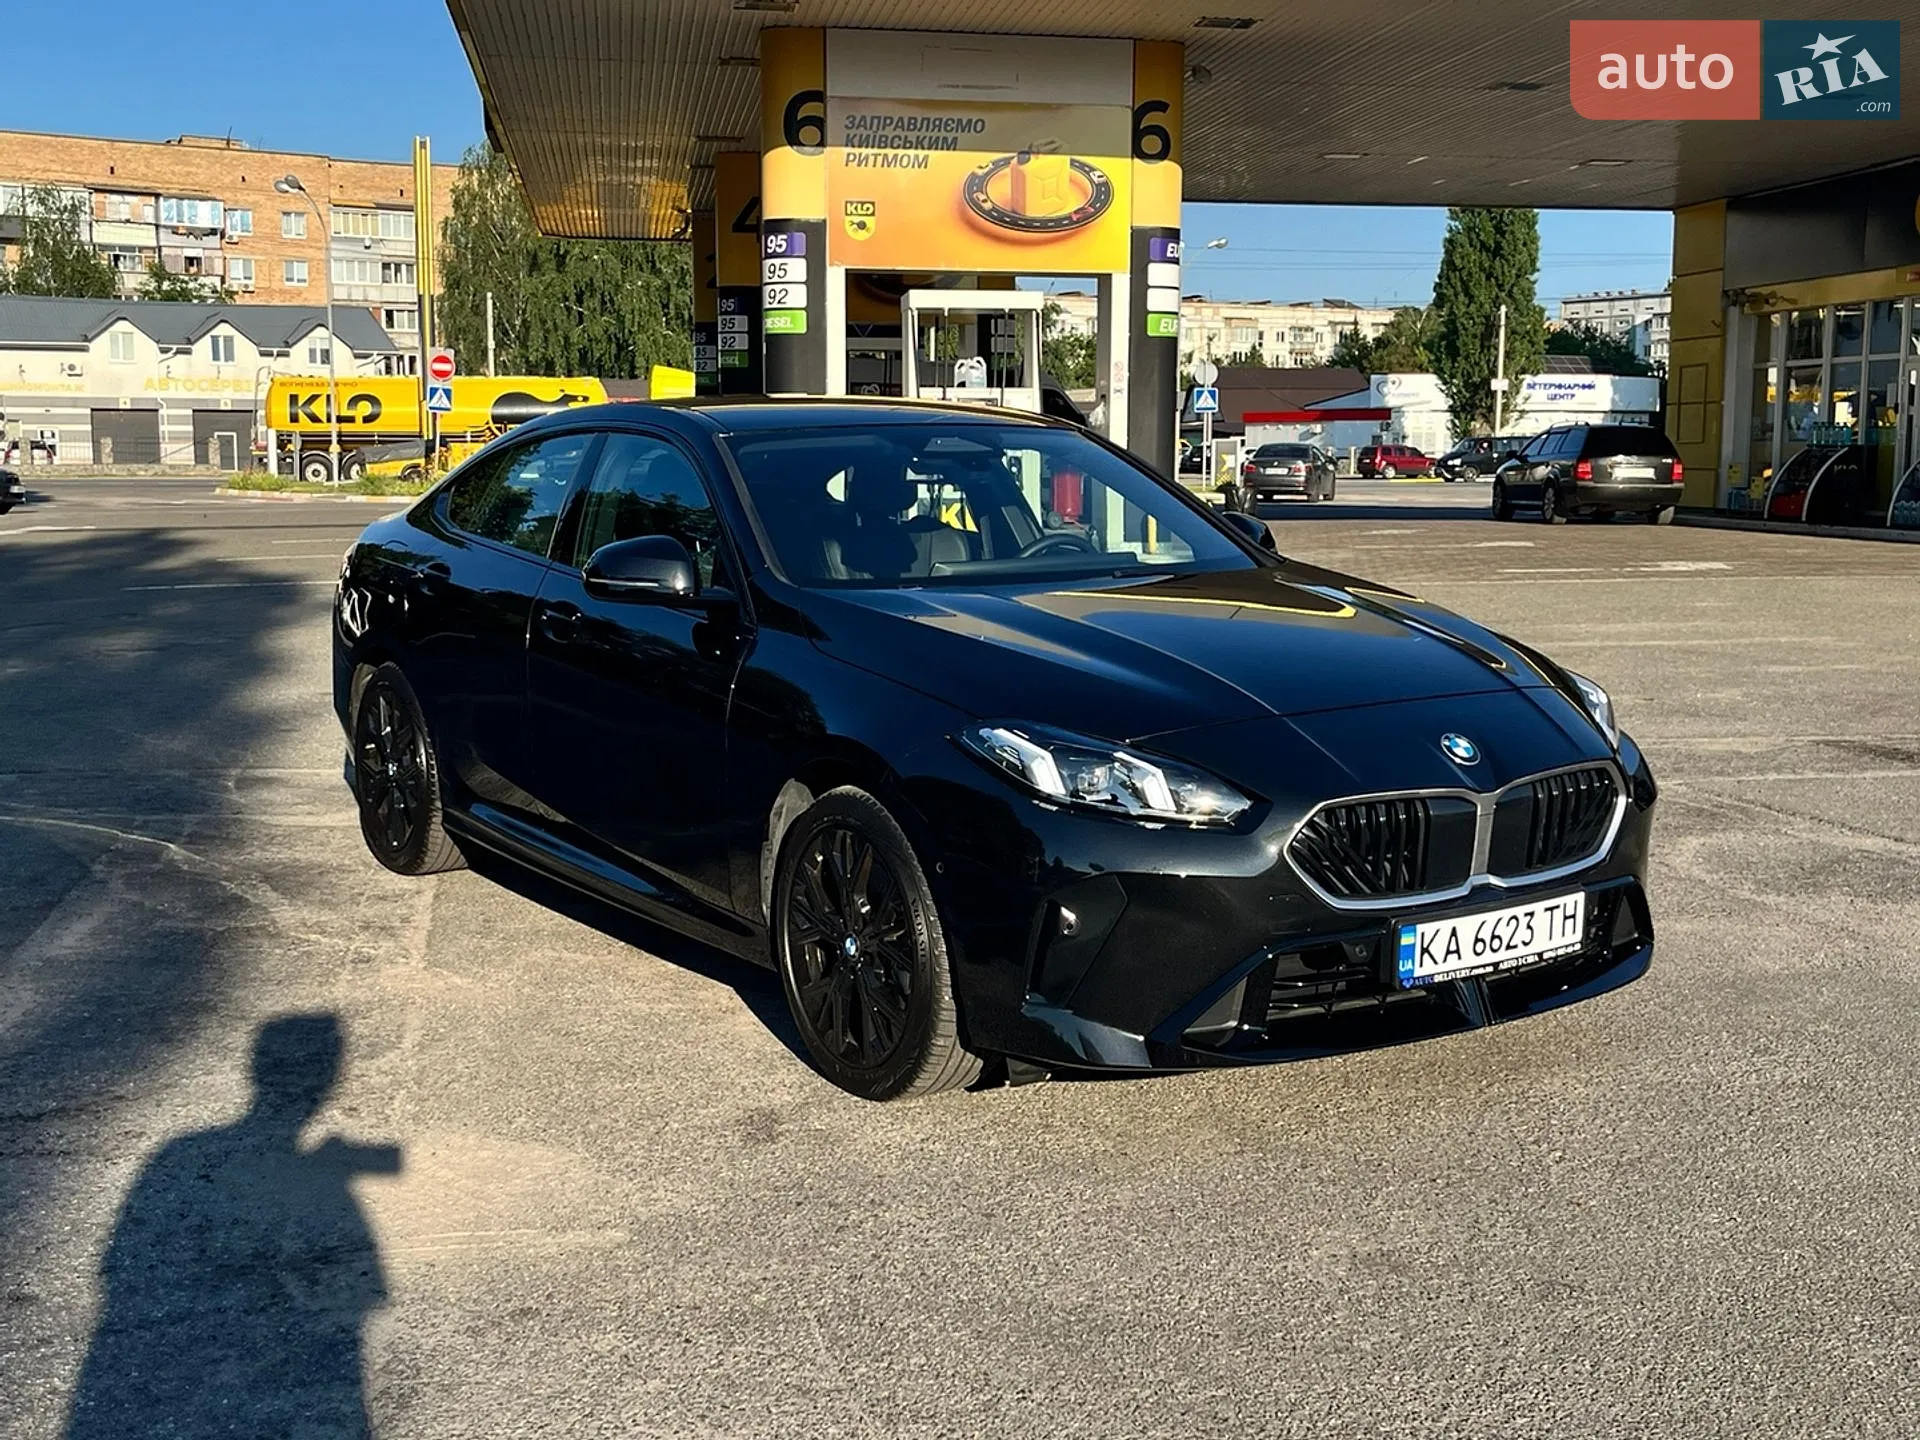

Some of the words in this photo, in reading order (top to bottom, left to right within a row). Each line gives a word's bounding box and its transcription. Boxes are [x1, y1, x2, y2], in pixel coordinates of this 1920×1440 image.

[783, 89, 825, 156] 6
[844, 114, 985, 134] ЗАПРАВЛЯЄМО
[844, 131, 958, 151] КИЇВСЬКИМ
[1133, 100, 1171, 165] 6
[845, 152, 929, 169] РИТМОМ
[846, 202, 874, 214] KLO
[767, 235, 787, 254] 95
[767, 263, 788, 279] 95
[720, 299, 735, 312] 95
[767, 289, 788, 305] 92
[720, 317, 736, 329] 95
[720, 336, 736, 348] 92
[289, 393, 382, 423] KLO
[1419, 926, 1462, 968] KA
[1473, 910, 1536, 957] 6623
[1544, 900, 1579, 941] TH
[1399, 959, 1413, 971] UA
